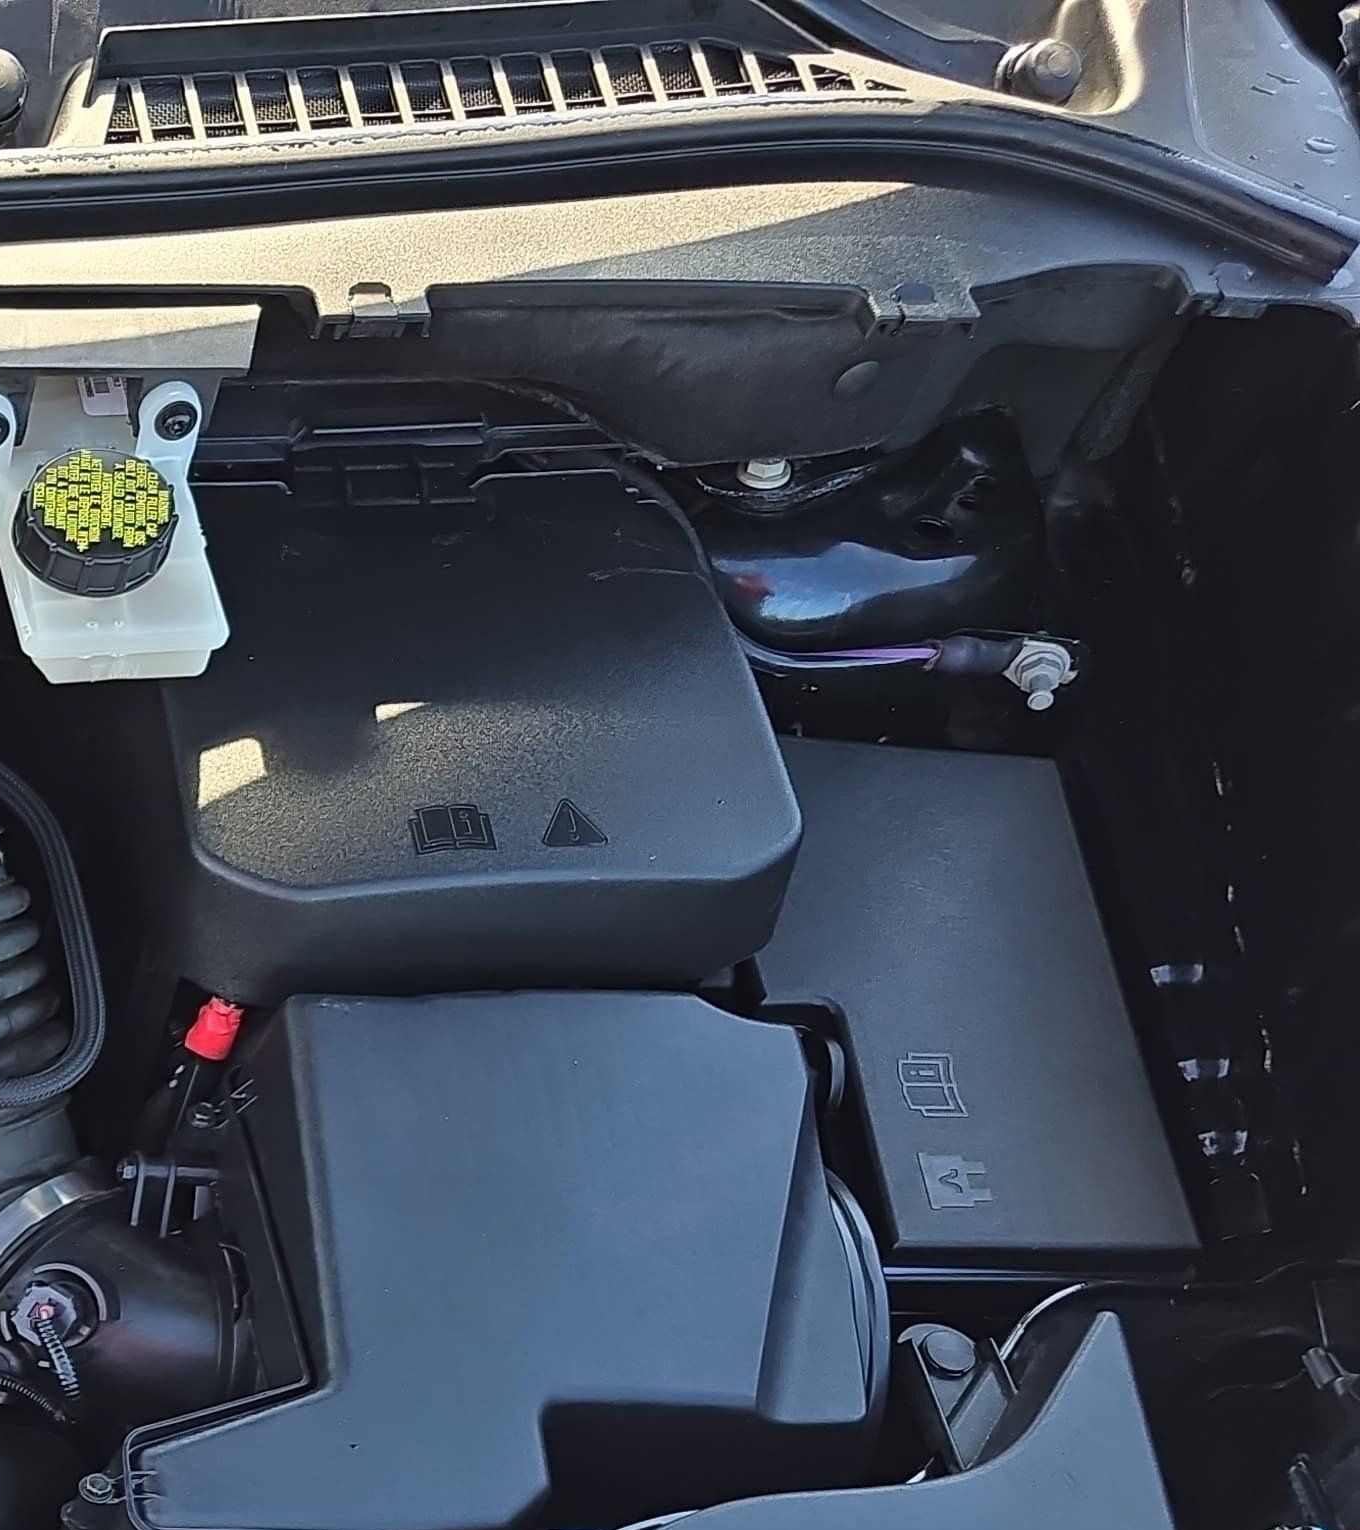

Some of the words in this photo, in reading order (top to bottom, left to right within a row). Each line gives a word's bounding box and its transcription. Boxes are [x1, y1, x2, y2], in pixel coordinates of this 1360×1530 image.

[69, 456, 79, 482] PLOYER
[80, 450, 91, 469] AVANT
[126, 459, 136, 478] ONLY
[91, 458, 101, 492] NETTOYER
[114, 471, 124, 497] SEALED
[125, 479, 135, 492] DOT
[136, 463, 146, 488] BEFORE
[147, 472, 158, 494] CLEAN
[68, 484, 79, 498] QUE
[44, 487, 56, 526] CONTENANT
[55, 489, 67, 530] PROVENANT
[124, 504, 135, 524] FLUID
[147, 497, 157, 520] FILLER
[66, 514, 78, 542] LIQUIDE
[123, 526, 134, 547] FROM
[135, 531, 145, 546] USE
[146, 523, 157, 538] CAP
